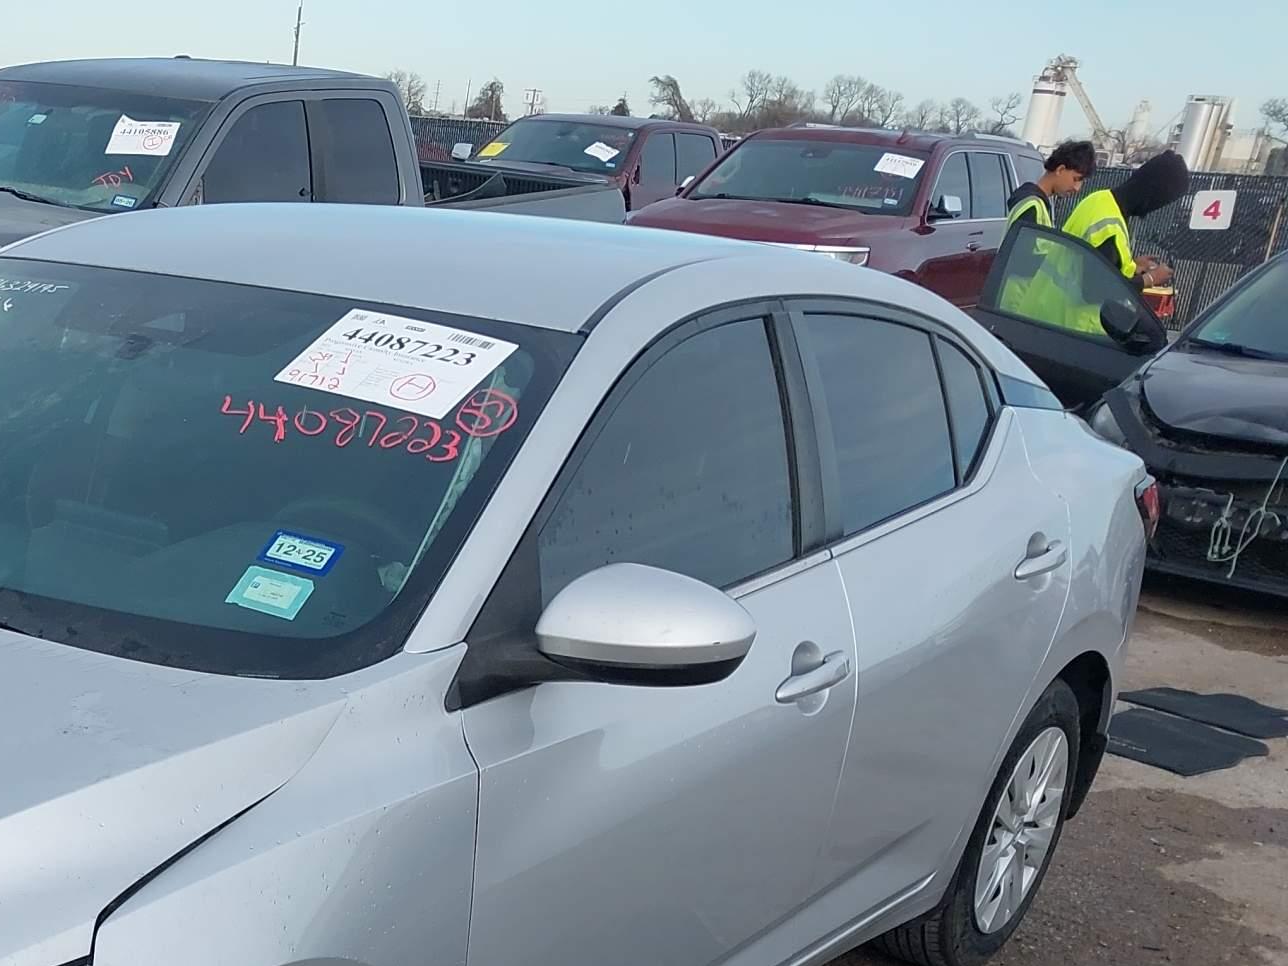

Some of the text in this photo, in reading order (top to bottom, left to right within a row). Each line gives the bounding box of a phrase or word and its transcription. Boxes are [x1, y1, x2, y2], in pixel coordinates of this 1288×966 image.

[1202, 200, 1222, 220] 4
[342, 327, 477, 367] 44087223
[221, 394, 461, 462] 44087223
[275, 542, 297, 556] 12
[301, 549, 328, 563] 25
